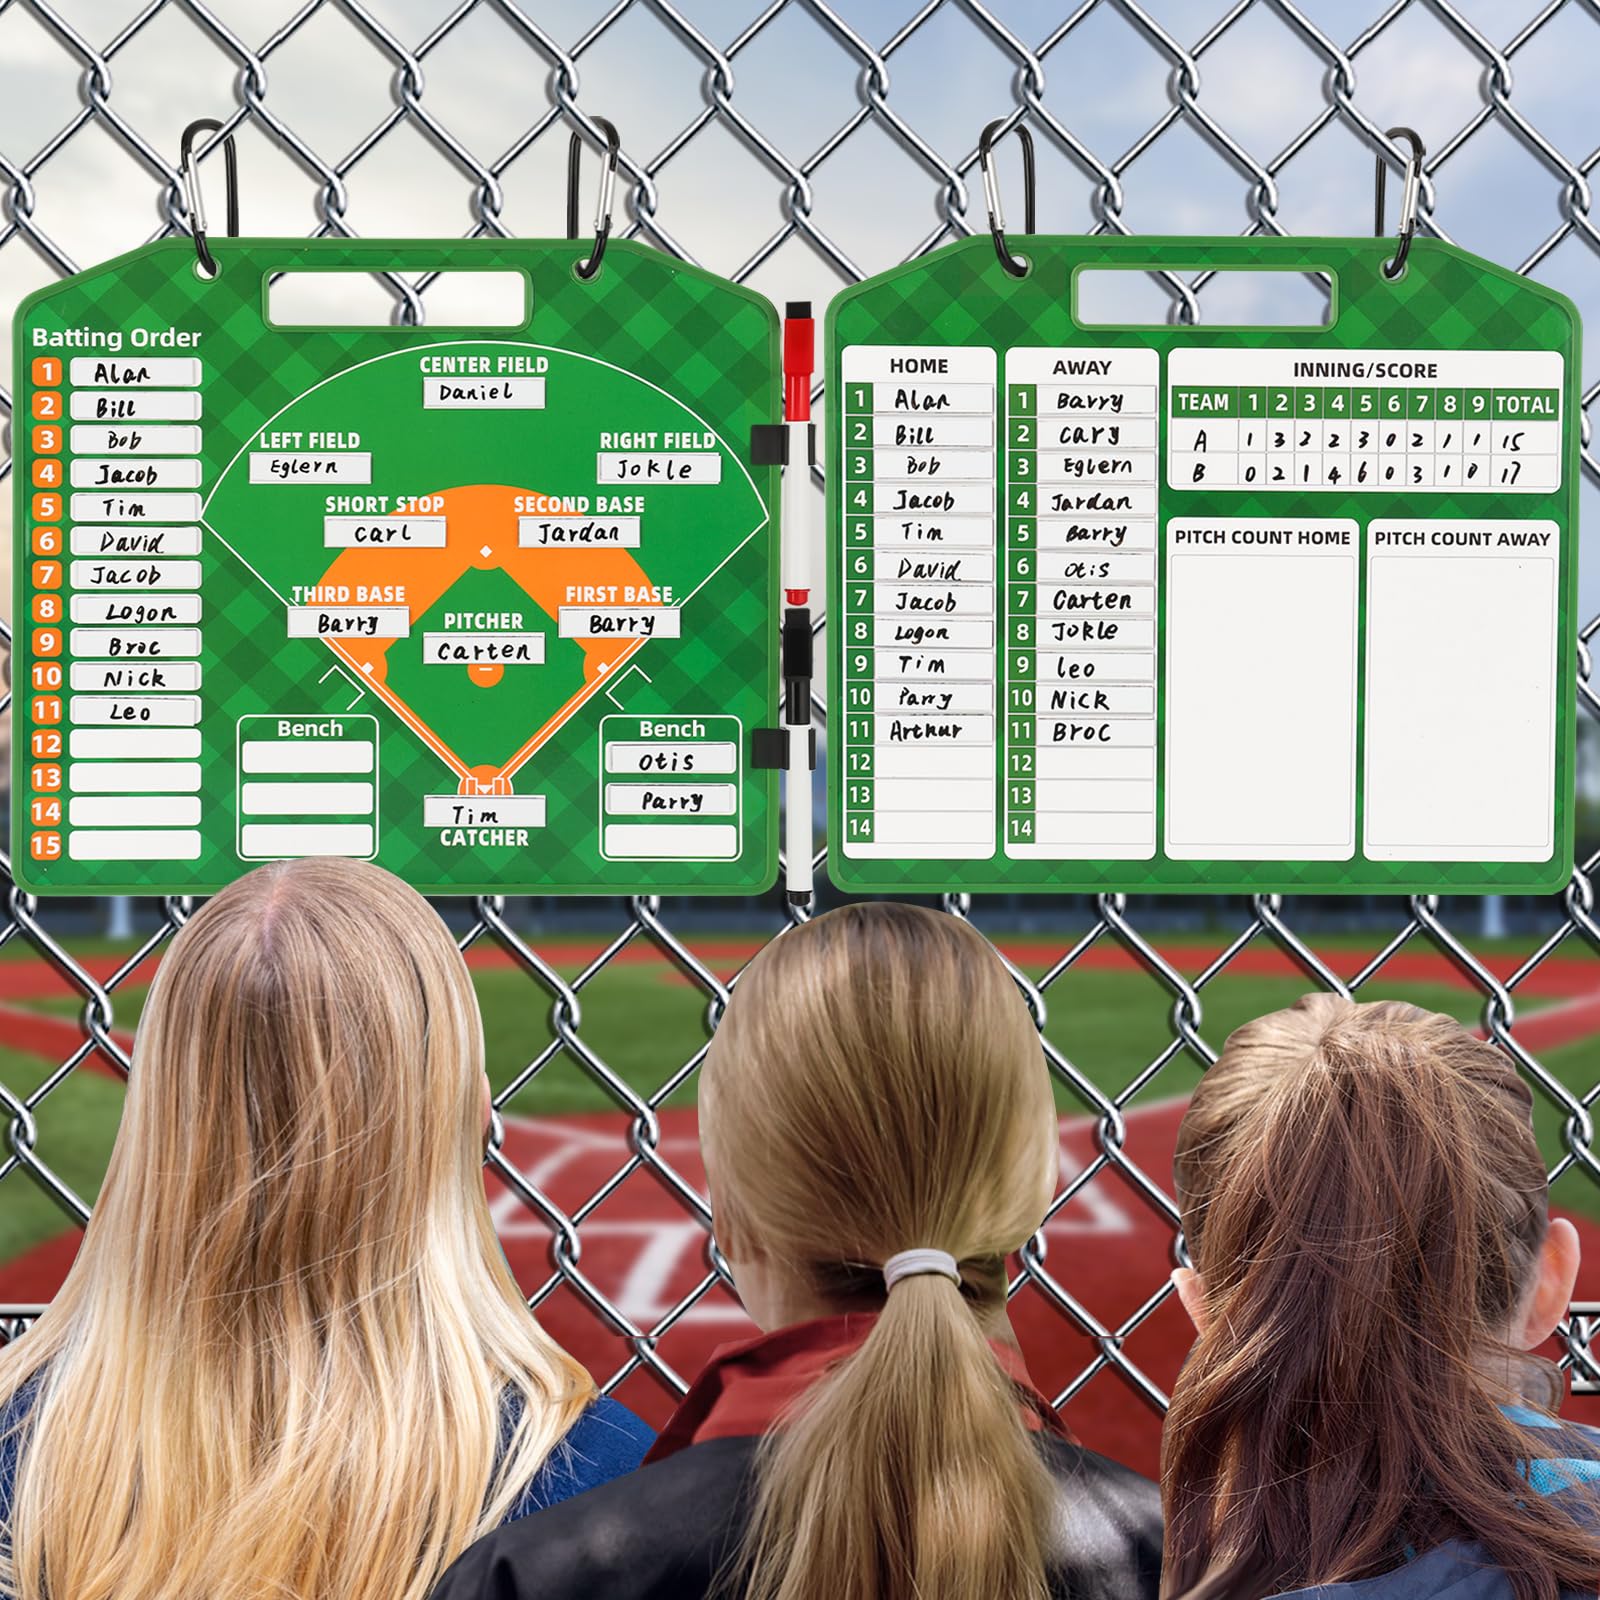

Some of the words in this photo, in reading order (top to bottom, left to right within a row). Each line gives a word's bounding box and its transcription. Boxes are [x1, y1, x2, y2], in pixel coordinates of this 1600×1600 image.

[32, 326, 122, 352] Batting
[130, 326, 202, 347] Order
[42, 362, 52, 381] 1
[94, 362, 151, 385] Alan
[419, 356, 491, 373] CENTER
[497, 356, 549, 373] FIELD
[890, 358, 948, 374] HOME
[1052, 360, 1112, 376] AWAY
[1294, 362, 1438, 379] INNING/SCORE
[439, 382, 513, 401] Daniel
[855, 389, 864, 407] 1
[894, 388, 951, 411] Alan
[1018, 391, 1027, 409] 1
[40, 396, 55, 415] 2
[96, 397, 136, 419] Bill
[1057, 392, 1124, 414] Barry
[1178, 393, 1229, 411] TEAM
[1248, 393, 1257, 411] 1
[1275, 393, 1288, 411] 2
[1304, 394, 1316, 412] 3
[1331, 394, 1345, 412] 4
[1360, 394, 1372, 412] 5
[1388, 394, 1401, 412] 6
[1416, 395, 1428, 413] 7
[1443, 395, 1457, 413] 8
[1472, 395, 1485, 413] 9
[1495, 396, 1555, 414] TOTAL
[40, 430, 54, 449] 3
[108, 430, 142, 450] Bob
[260, 432, 303, 449] LEFT
[309, 432, 360, 449] FIELD
[600, 432, 658, 449] RIGHT
[664, 432, 715, 449] FIELD
[854, 423, 867, 441] 2
[895, 424, 934, 446] Bill
[1017, 424, 1030, 442] 2
[1193, 429, 1207, 453] A
[1247, 432, 1253, 447] 1
[1274, 431, 1286, 448] 3
[1299, 430, 1312, 447] 2
[1328, 433, 1340, 449] 2
[1358, 431, 1370, 449] 3
[1385, 433, 1397, 447] 0
[1411, 433, 1424, 448] 2
[1442, 433, 1452, 449] 1
[1473, 433, 1481, 446] 1
[1502, 432, 1525, 452] 15
[39, 464, 55, 483] 4
[854, 456, 866, 474] 3
[907, 455, 941, 476] Bob
[1017, 458, 1029, 475] 3
[1192, 463, 1206, 483] B
[1245, 466, 1256, 483] 0
[1272, 466, 1286, 481] 2
[1303, 464, 1310, 483] 1
[1327, 466, 1342, 485] 4
[1357, 460, 1367, 484] 6
[1385, 466, 1395, 481] 0
[1413, 465, 1423, 484] 3
[1443, 464, 1451, 478] 1
[1467, 462, 1478, 479] 0
[1501, 460, 1521, 485] 17
[94, 464, 158, 486] Jacob
[40, 498, 54, 517] 5
[102, 498, 146, 517] Tim
[325, 495, 389, 513] SHORT
[396, 495, 445, 513] STOP
[514, 495, 590, 513] SECOND
[596, 496, 645, 513] BASE
[853, 490, 867, 507] 4
[892, 489, 955, 512] Jacob
[1016, 491, 1030, 509] 4
[1051, 492, 1133, 512] Jardan
[538, 521, 619, 545] Jardan
[855, 523, 867, 540] 5
[901, 522, 944, 541] Tim
[1017, 524, 1029, 542] 5
[1065, 525, 1128, 548] Barry
[1175, 530, 1226, 544] PITCH
[1231, 530, 1293, 545] COUNT
[1298, 531, 1351, 545] HOME
[1375, 531, 1425, 546] PITCH
[1431, 532, 1493, 546] COUNT
[1496, 532, 1551, 547] AWAY
[39, 531, 55, 551] 6
[100, 531, 165, 554] David
[854, 556, 867, 574] 6
[897, 557, 962, 582] David
[1017, 557, 1029, 575] 6
[40, 565, 54, 584] 7
[90, 564, 162, 586] Jacob
[292, 585, 350, 603] THIRD
[356, 585, 405, 603] BASE
[566, 585, 618, 603] FIRST
[624, 586, 673, 603] BASE
[854, 589, 867, 606] 7
[895, 591, 957, 613] Jacob
[1017, 590, 1029, 607] 7
[39, 599, 55, 618] 8
[318, 613, 379, 636] Barry
[444, 612, 523, 630] PITCHER
[589, 614, 655, 636] Barry
[854, 622, 868, 640] 8
[1016, 623, 1029, 641] 8
[39, 633, 55, 652] 9
[108, 637, 161, 657] Broc
[854, 655, 868, 672] 9
[898, 654, 945, 674] Tim
[1016, 656, 1029, 673] 9
[33, 666, 62, 686] 10
[103, 668, 166, 688] Nick
[850, 687, 871, 705] 10
[1012, 689, 1033, 706] 10
[35, 700, 60, 719] 11
[109, 703, 151, 721] Leo
[278, 719, 343, 737] Bench
[640, 719, 705, 737] Bench
[850, 720, 869, 738] 11
[1011, 721, 1030, 739] 11
[33, 734, 61, 753] 12
[850, 753, 871, 771] 12
[1011, 754, 1032, 771] 12
[32, 768, 61, 787] 13
[642, 791, 704, 813] Parry
[850, 786, 870, 803] 13
[1011, 787, 1032, 804] 13
[32, 802, 61, 821] 14
[452, 805, 499, 825] Tim
[850, 818, 871, 836] 14
[1011, 819, 1032, 837] 14
[32, 836, 61, 855] 15
[440, 829, 529, 847] CATCHER
